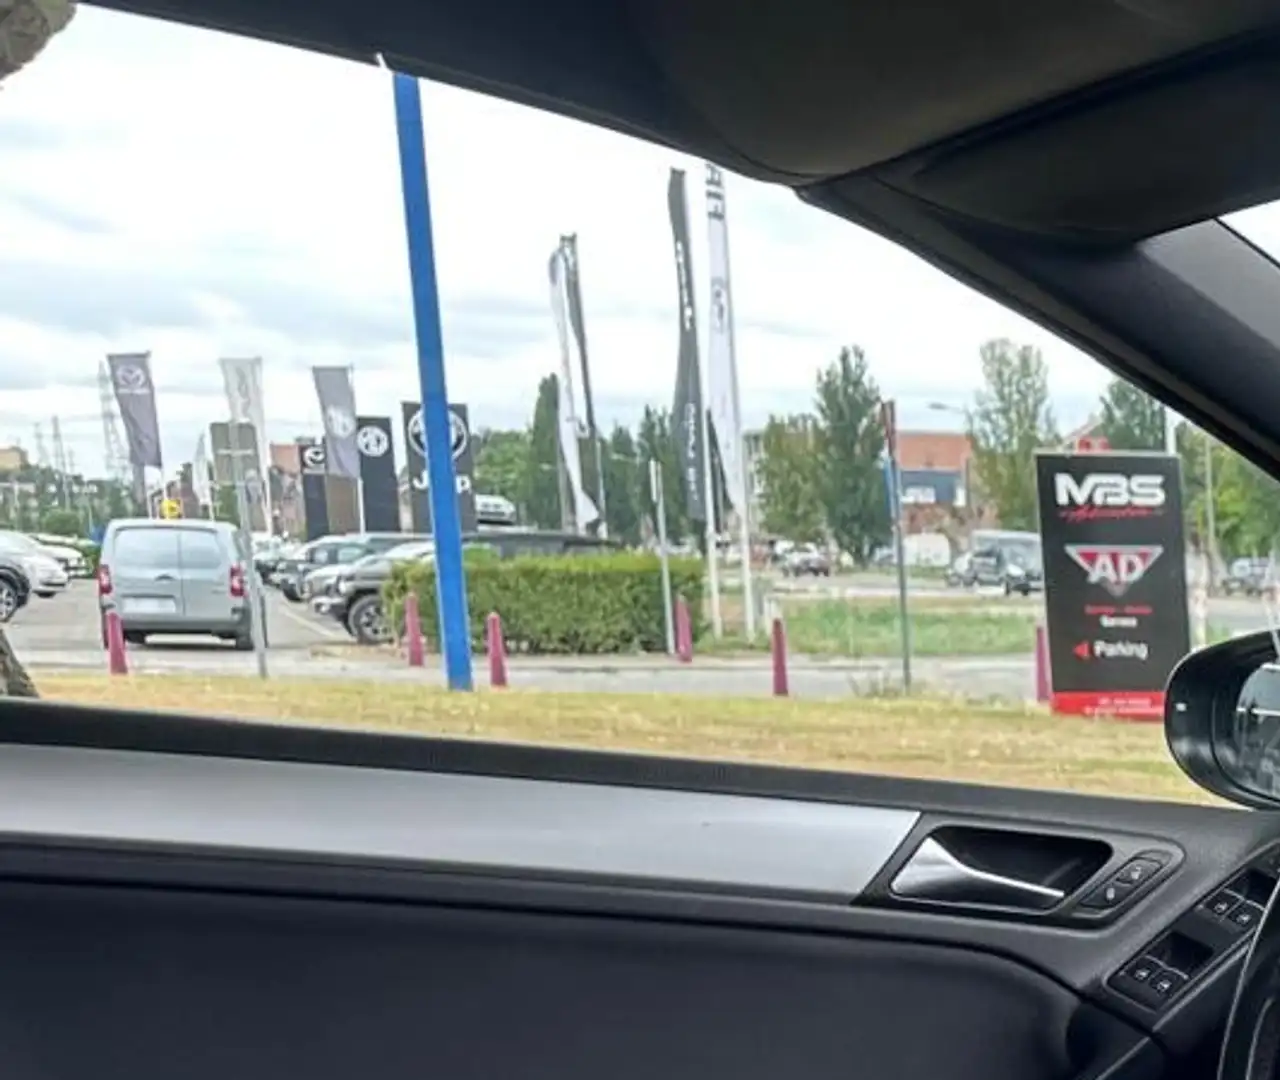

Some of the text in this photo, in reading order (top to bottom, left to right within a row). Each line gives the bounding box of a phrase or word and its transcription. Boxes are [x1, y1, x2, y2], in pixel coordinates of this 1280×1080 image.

[1055, 473, 1166, 505] MBS
[1088, 553, 1145, 584] AD
[1093, 640, 1148, 661] Parking
